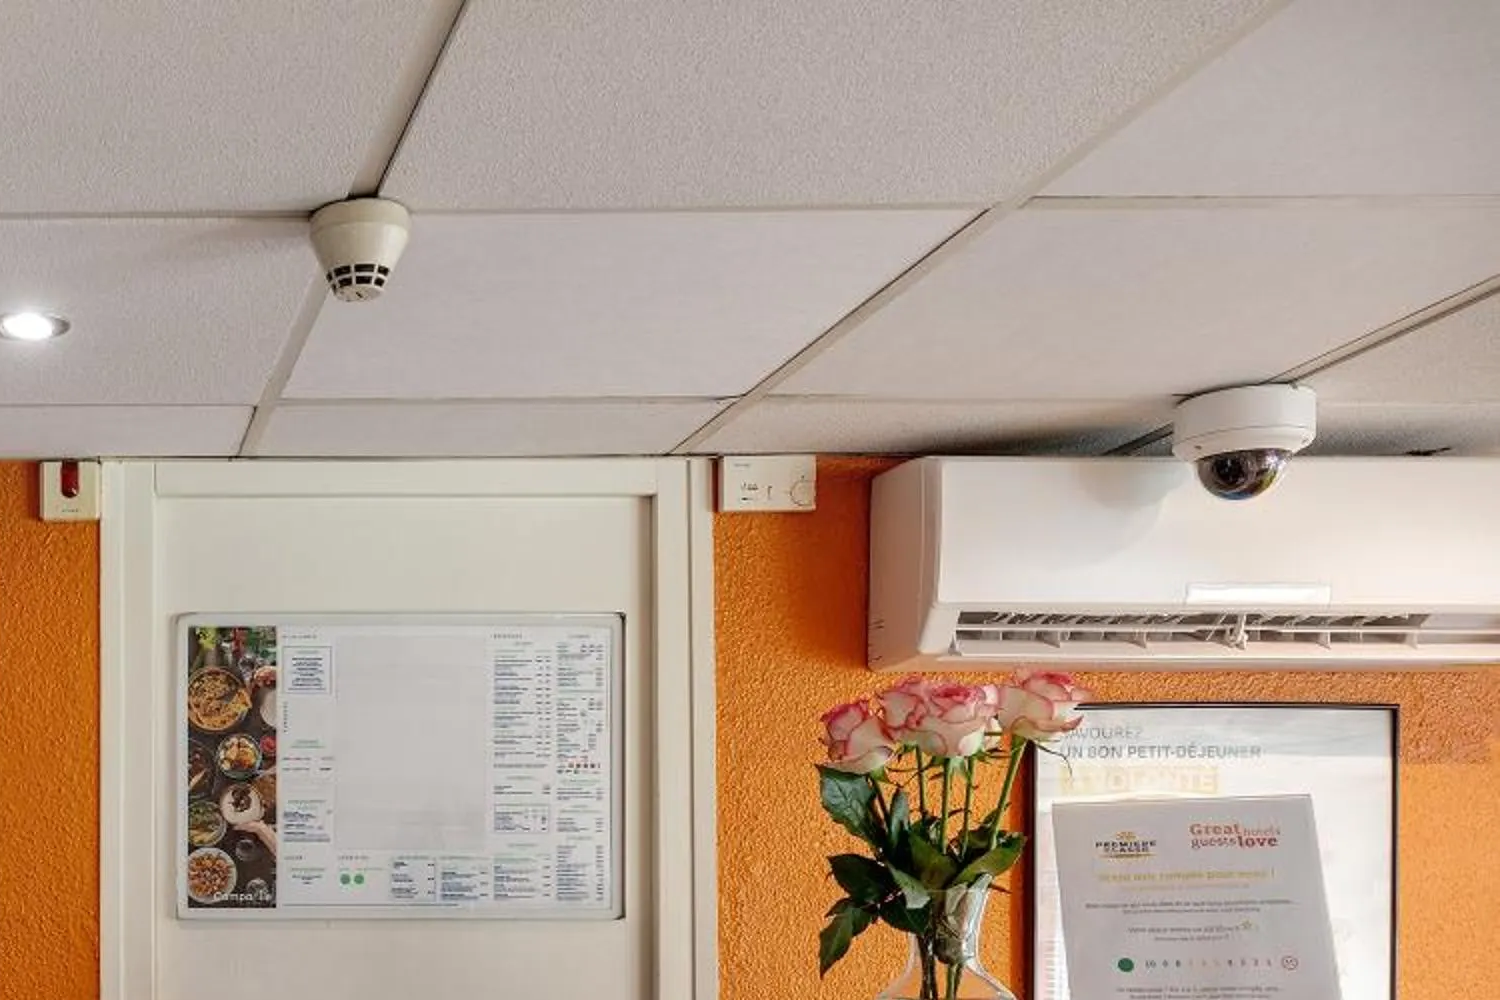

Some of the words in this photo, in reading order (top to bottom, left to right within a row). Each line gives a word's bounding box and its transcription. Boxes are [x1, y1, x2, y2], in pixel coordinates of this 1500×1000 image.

[1065, 727, 1143, 739] AVOUREZ
[1088, 745, 1122, 759] BON
[1127, 742, 1262, 759] PETIT-DÉJEUNER
[1190, 823, 1242, 835] Great
[1191, 836, 1237, 849] guests
[1238, 835, 1279, 848] love
